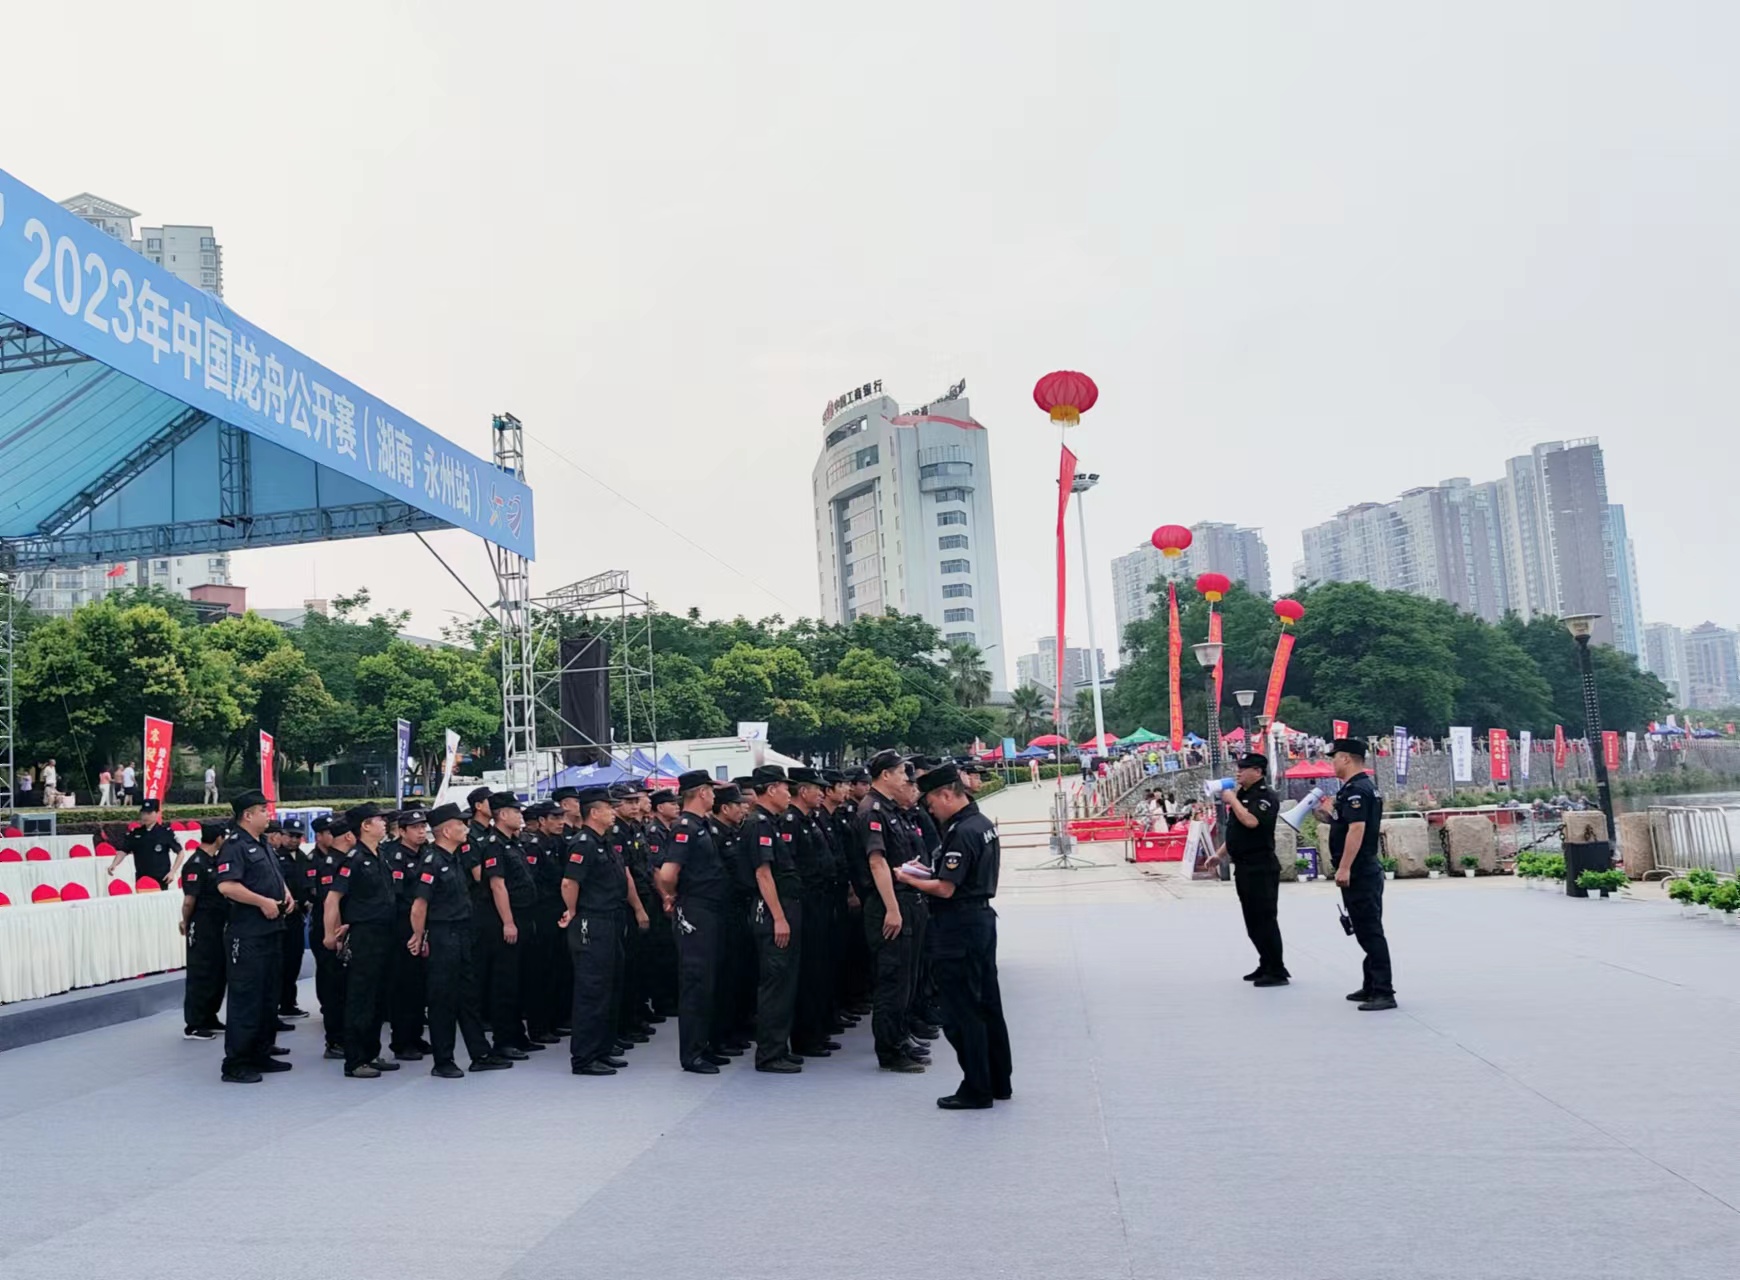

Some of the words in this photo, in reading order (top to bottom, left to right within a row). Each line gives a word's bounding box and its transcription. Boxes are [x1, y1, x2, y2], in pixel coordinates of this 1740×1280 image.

[834, 379, 882, 412] 中国工商银行
